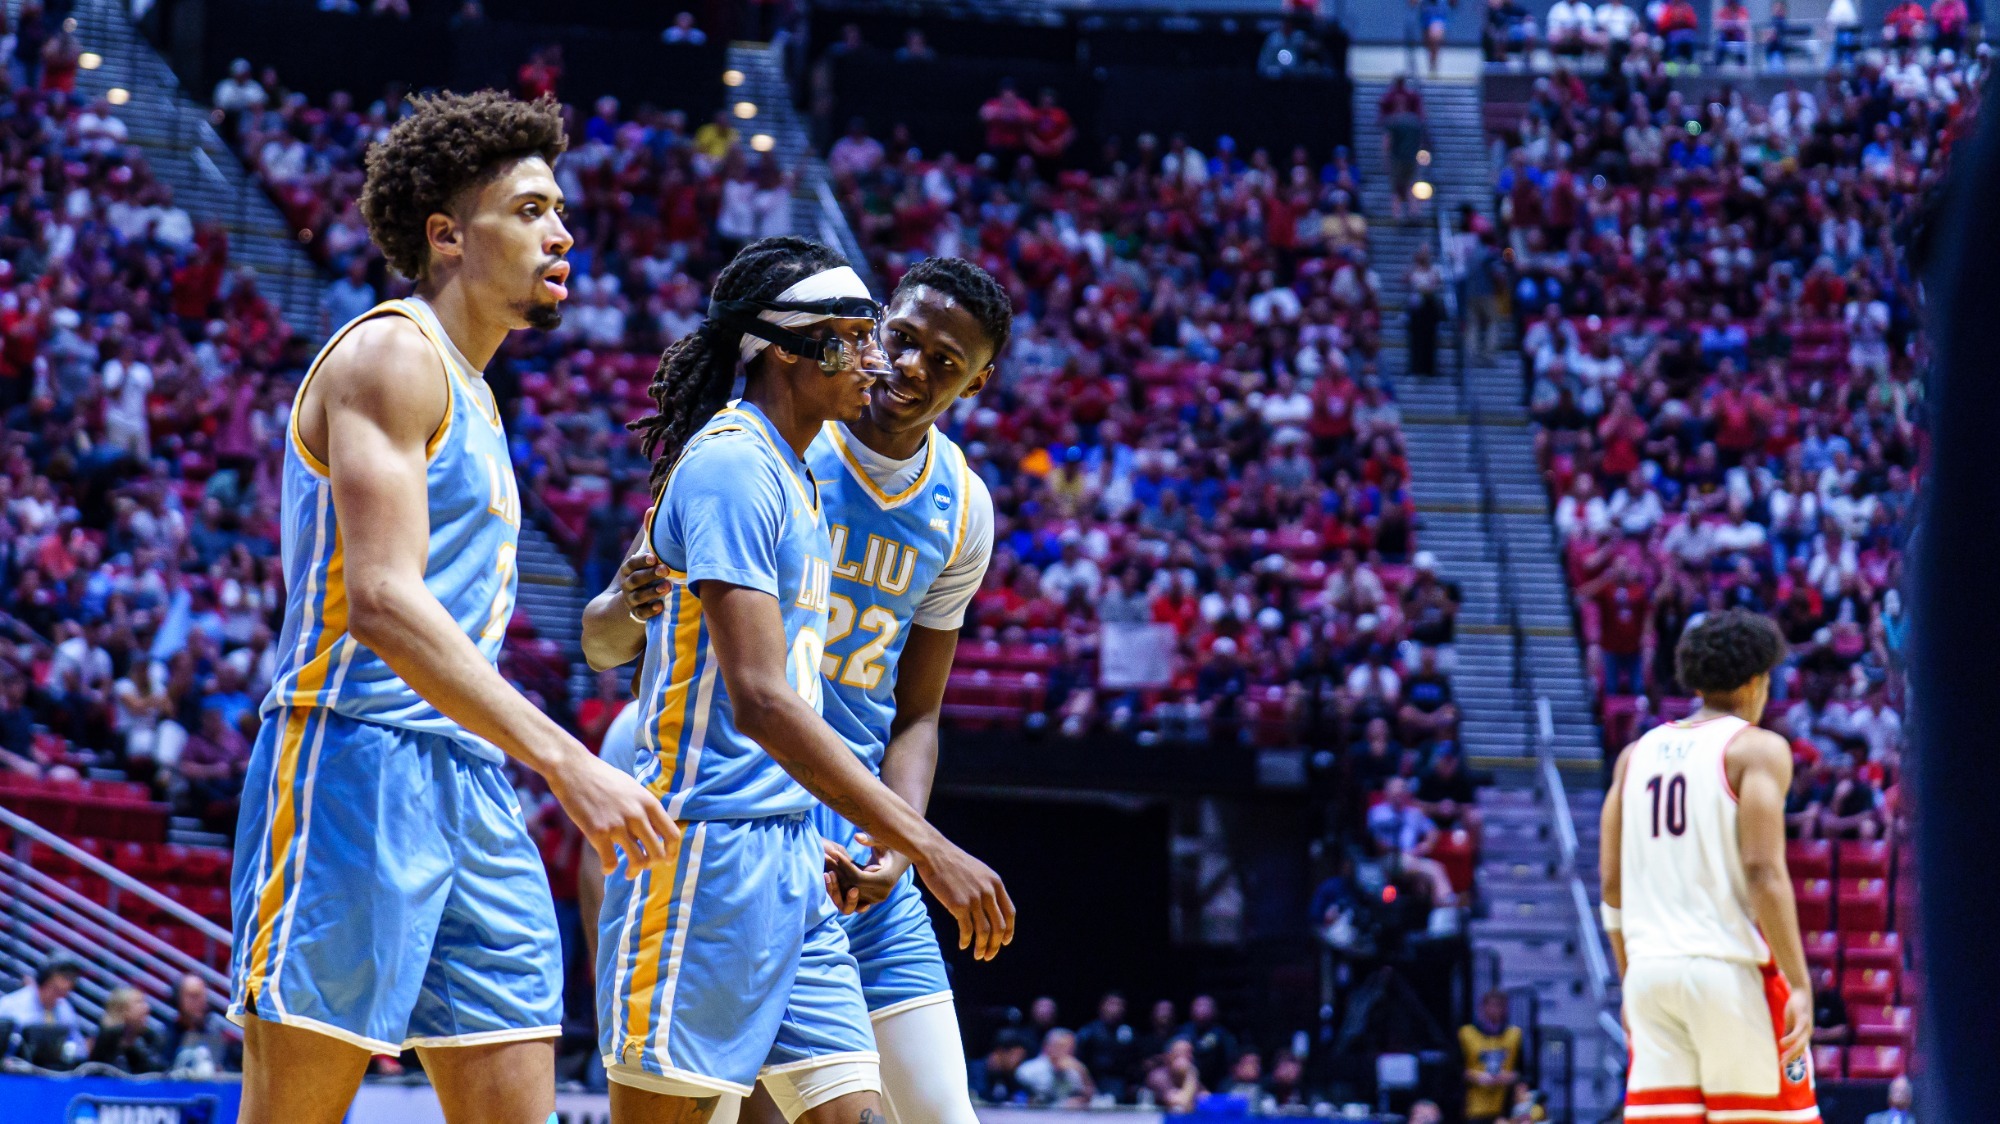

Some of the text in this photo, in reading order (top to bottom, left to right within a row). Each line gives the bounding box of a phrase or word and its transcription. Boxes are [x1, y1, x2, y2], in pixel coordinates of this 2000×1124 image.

[795, 554, 828, 613] LIU
[831, 524, 919, 596] LIU
[820, 592, 900, 689] 22
[1646, 772, 1687, 838] 10
